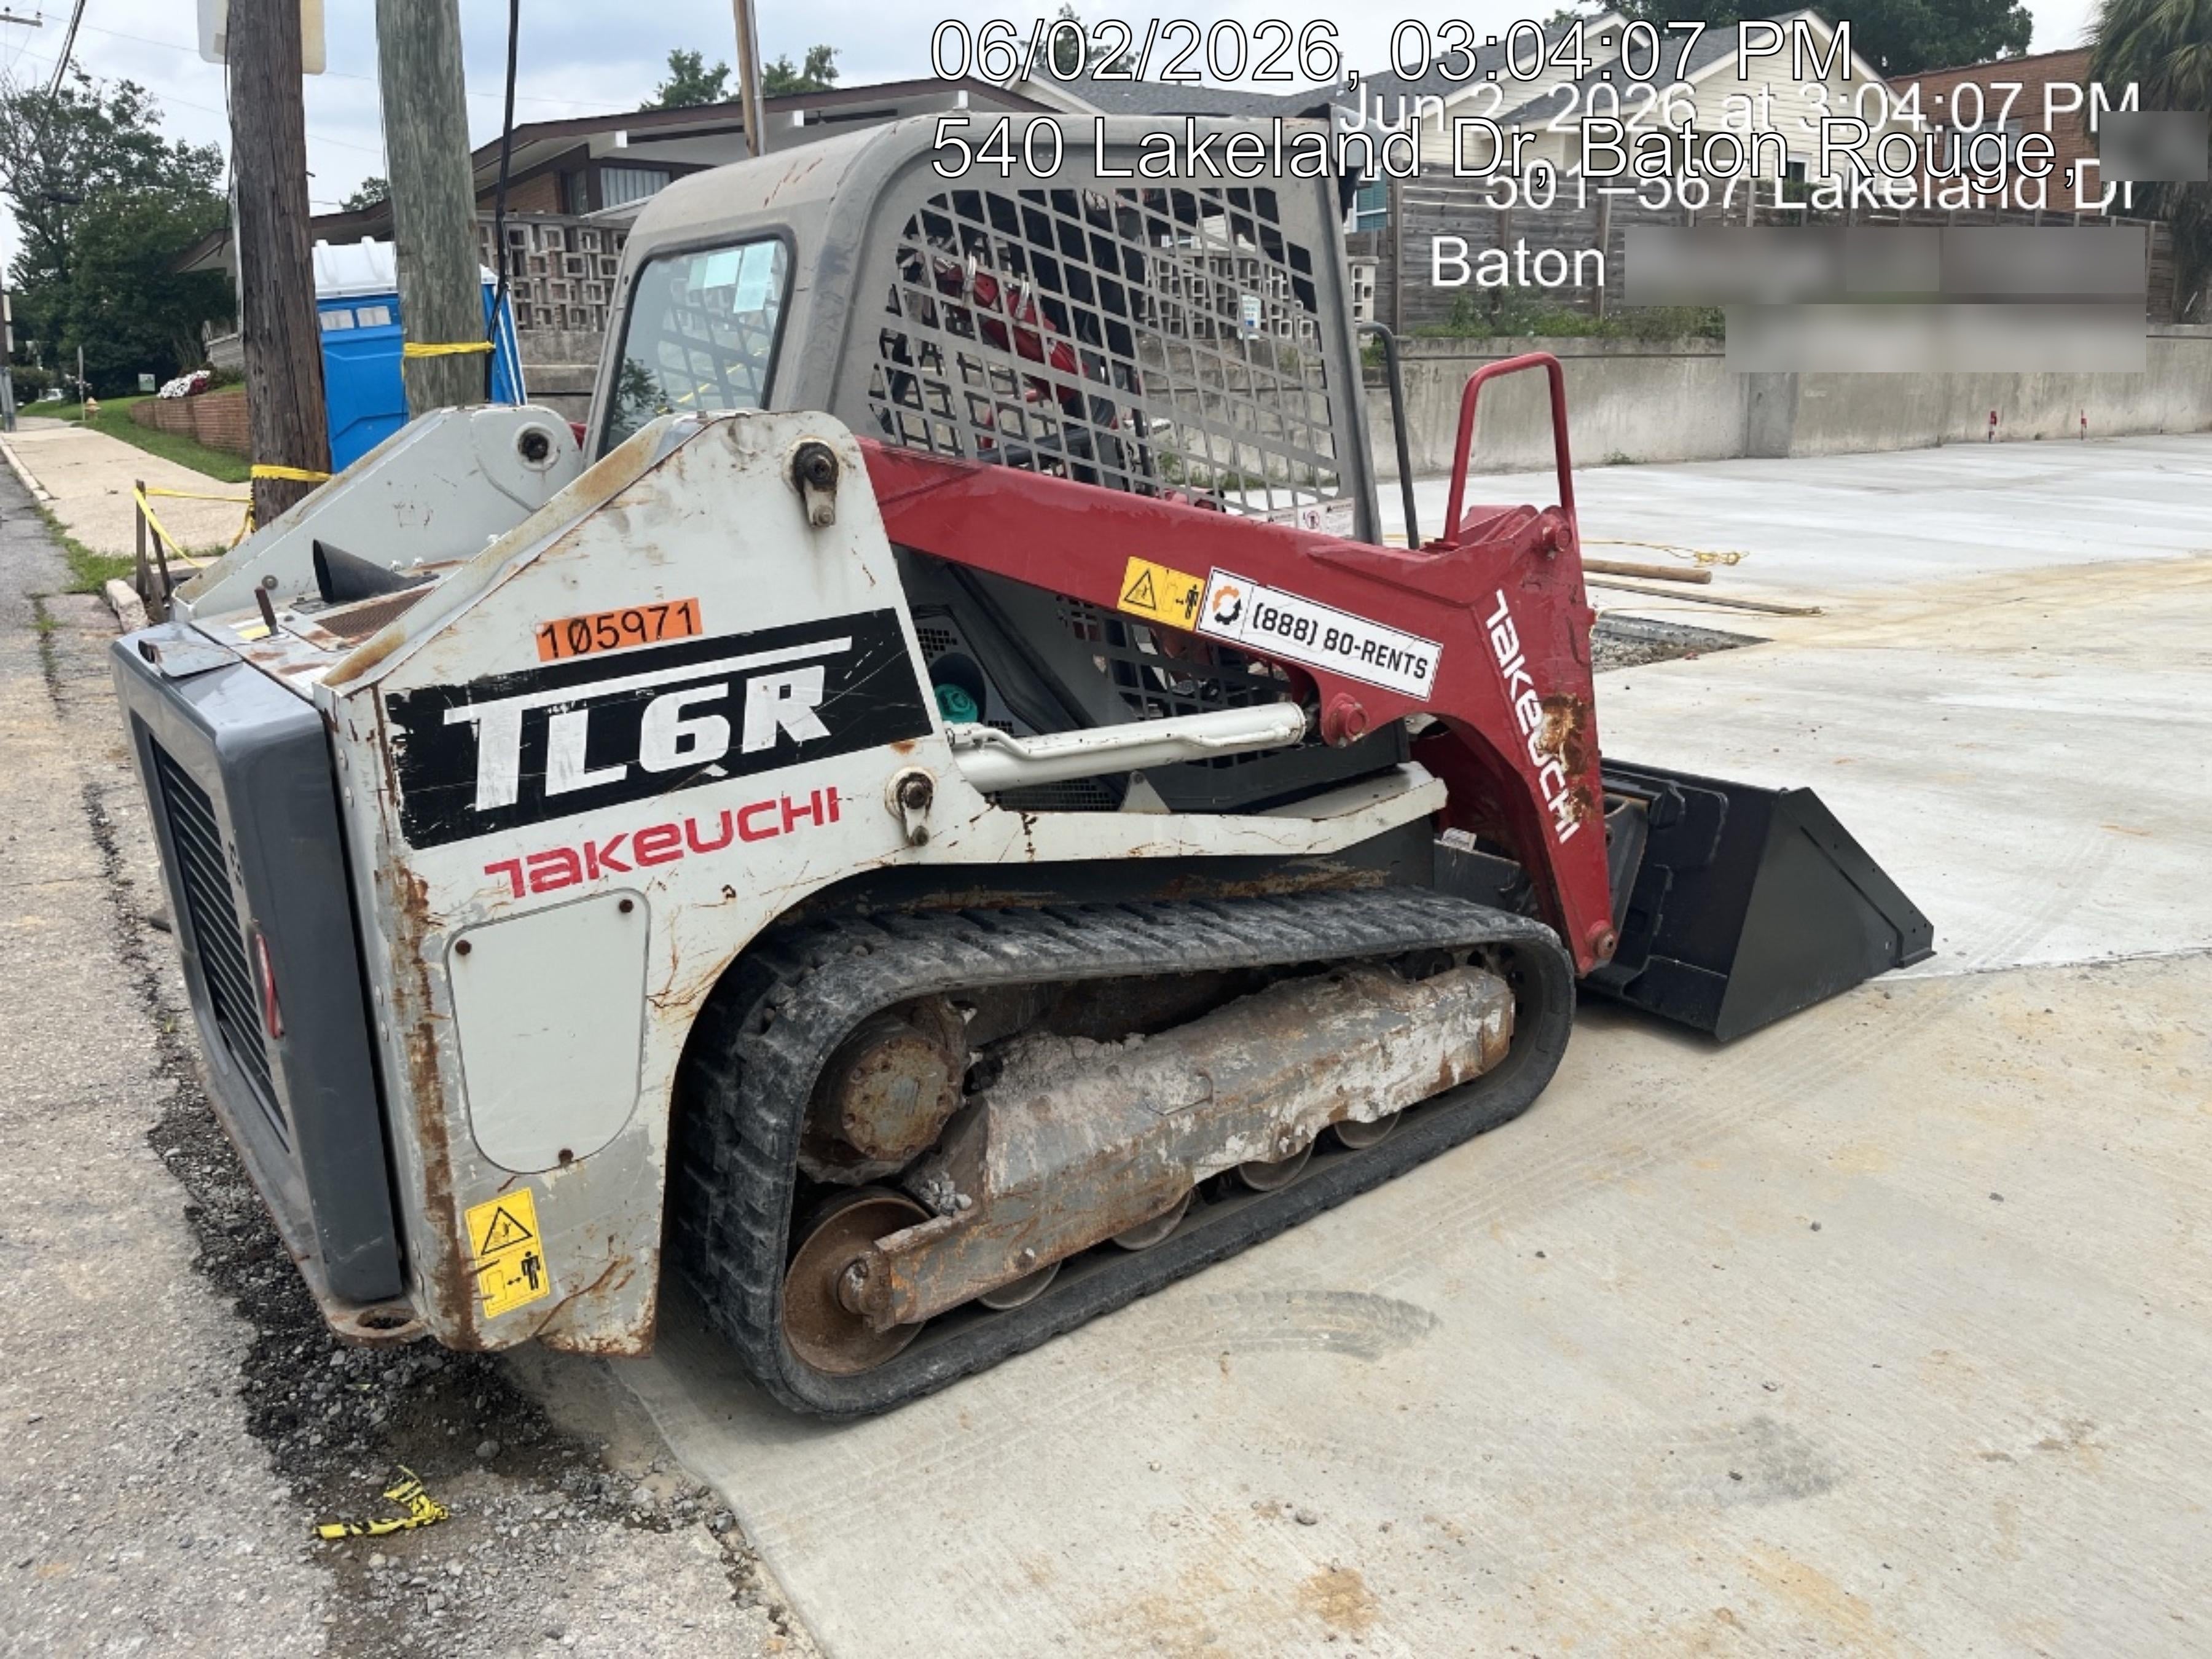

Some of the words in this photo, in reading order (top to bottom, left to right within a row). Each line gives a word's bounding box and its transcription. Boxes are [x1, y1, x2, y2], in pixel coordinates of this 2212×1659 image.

[540, 601, 694, 659] 105971
[1252, 602, 1319, 646] (888)
[1324, 628, 1429, 680] 80-RENTS
[443, 636, 853, 812] TL6R
